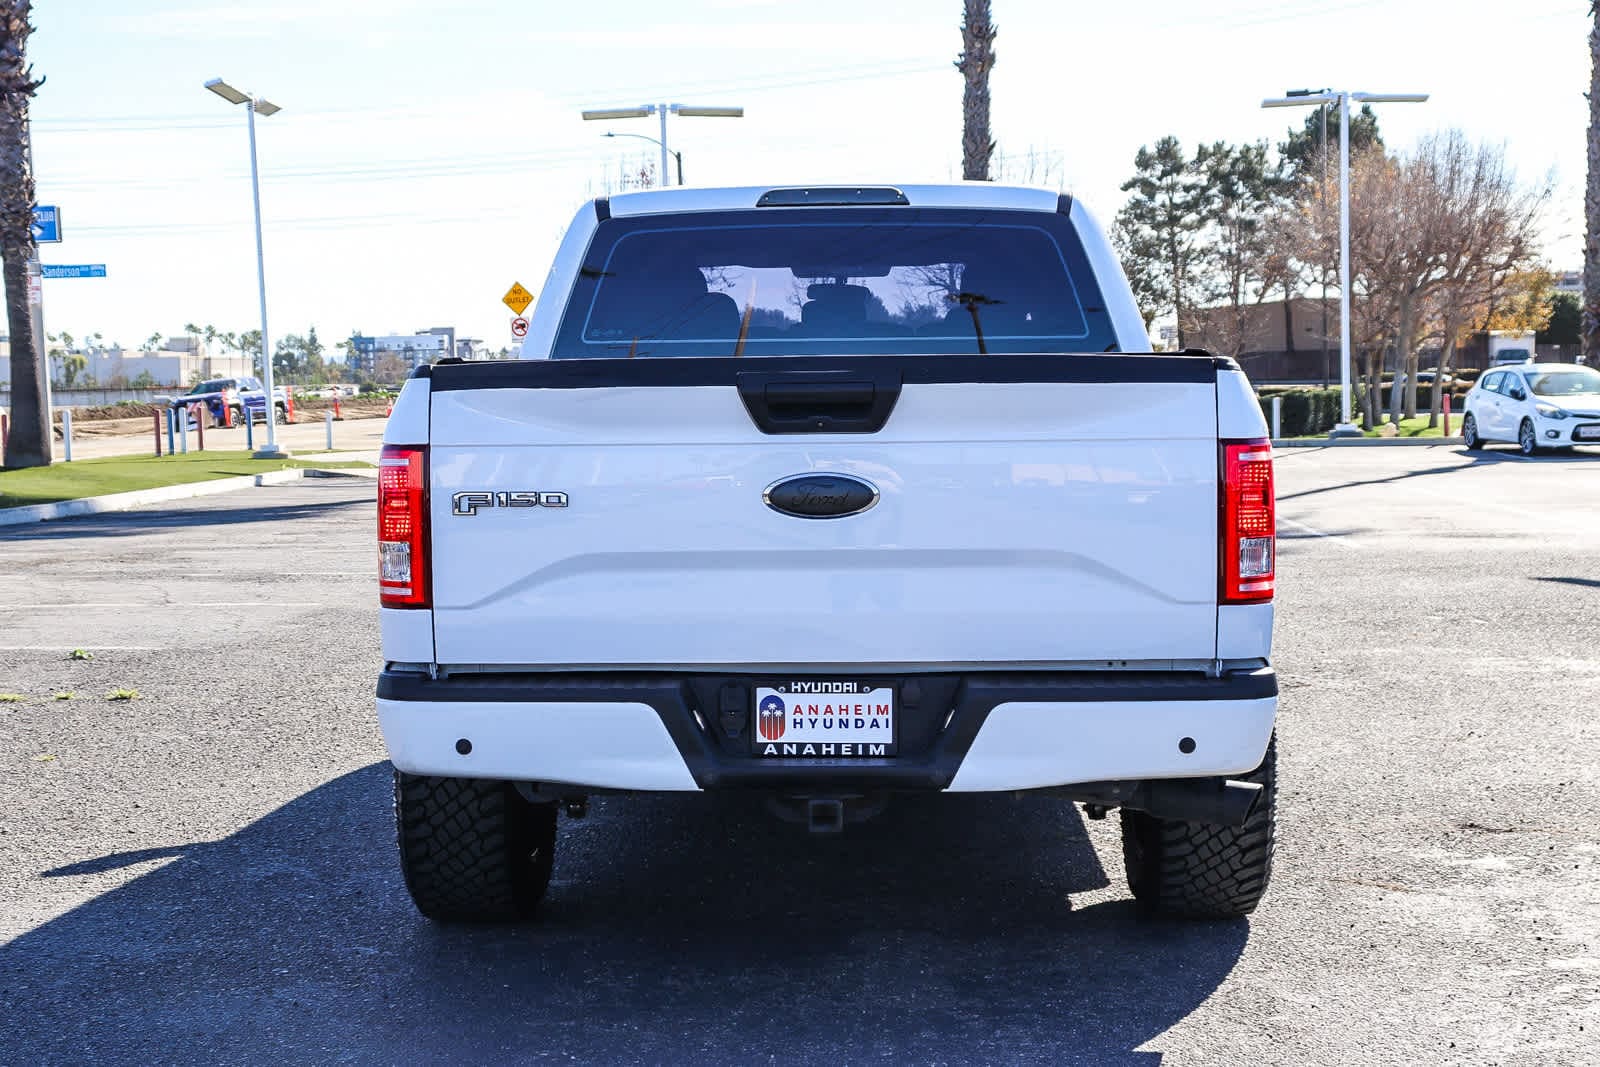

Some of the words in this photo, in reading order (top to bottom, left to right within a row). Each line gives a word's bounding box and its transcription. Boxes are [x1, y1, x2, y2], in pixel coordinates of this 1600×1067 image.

[42, 266, 80, 277] Sanderson
[791, 482, 849, 505] Ford
[791, 682, 857, 693] HYUNDAI
[793, 704, 889, 716] ANAHEIM
[793, 718, 889, 729] HYUNDAI
[763, 743, 885, 755] ANAHEIM
